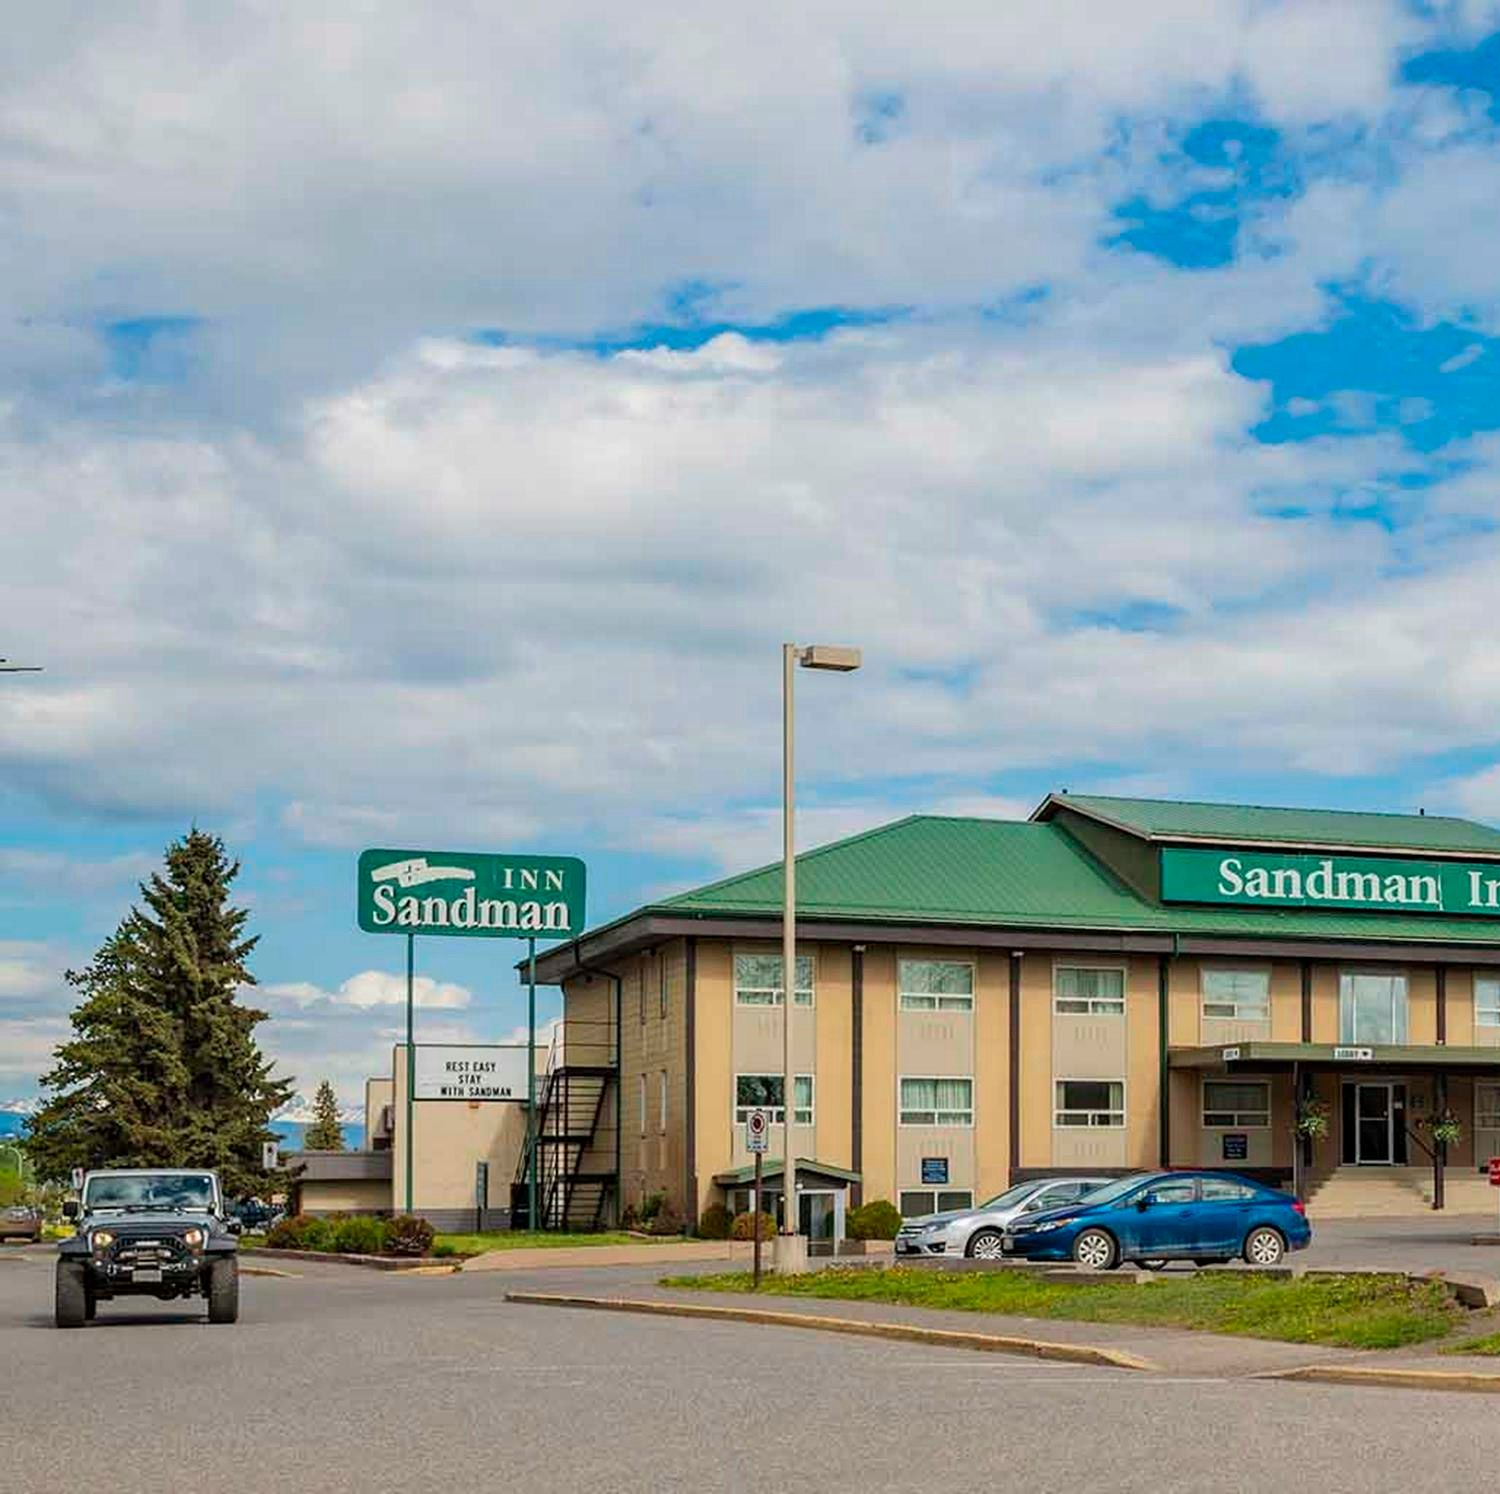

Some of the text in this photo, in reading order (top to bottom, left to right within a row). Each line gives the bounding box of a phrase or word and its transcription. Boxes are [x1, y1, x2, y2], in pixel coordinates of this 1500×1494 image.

[503, 867, 565, 891] INN
[1218, 858, 1441, 905] Sandman
[372, 885, 571, 931] Sandman
[446, 1061, 496, 1072] REST EASY
[458, 1074, 482, 1084] STAY
[441, 1087, 512, 1097] WITH SANDMAN
